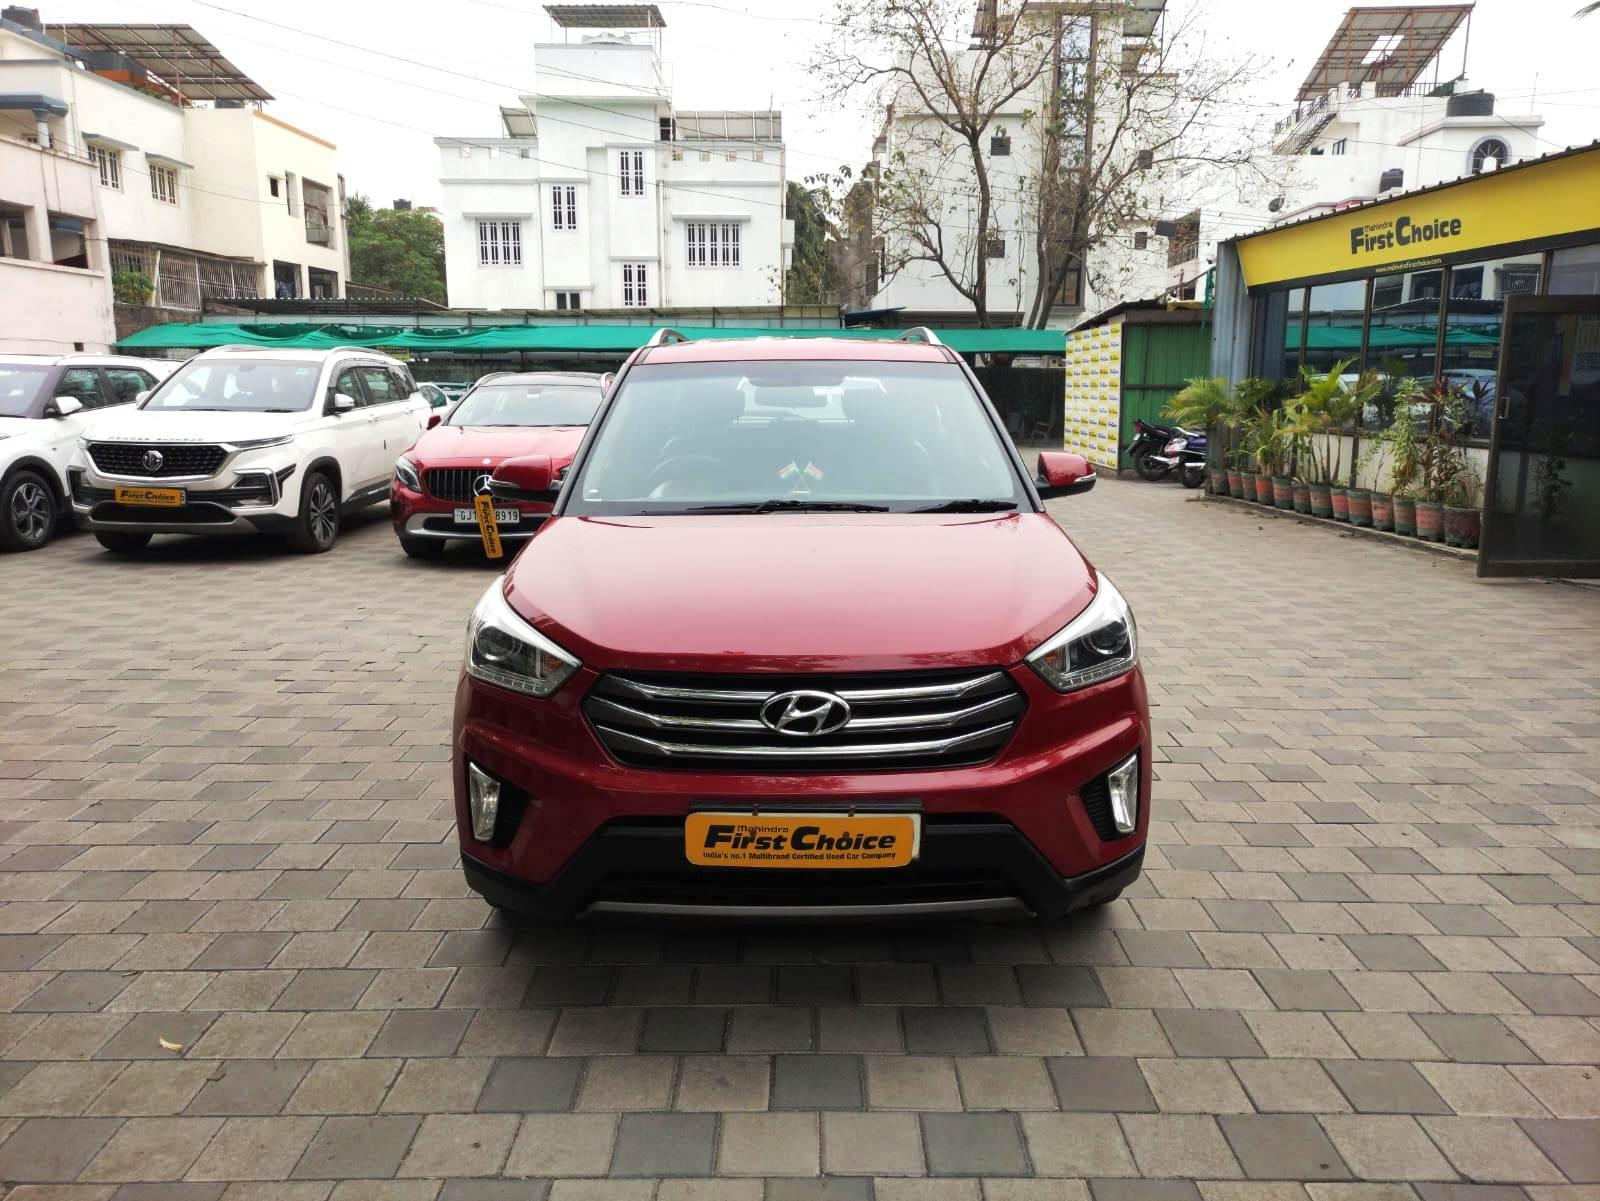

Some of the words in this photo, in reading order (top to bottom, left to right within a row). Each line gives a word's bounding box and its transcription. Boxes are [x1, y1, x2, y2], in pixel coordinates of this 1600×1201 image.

[1350, 226, 1394, 255] First
[1395, 215, 1462, 246] Choice
[120, 490, 145, 499] First
[495, 510, 518, 521] 8919
[737, 824, 789, 833] Mahindra
[703, 824, 788, 851] First
[790, 825, 897, 851] Choice
[703, 851, 728, 860] India's
[730, 851, 746, 860] no.1
[749, 852, 791, 860] Multibrand
[791, 852, 824, 861] Certified
[826, 852, 845, 860] Used
[846, 852, 860, 860] Car
[861, 852, 897, 860] Company
